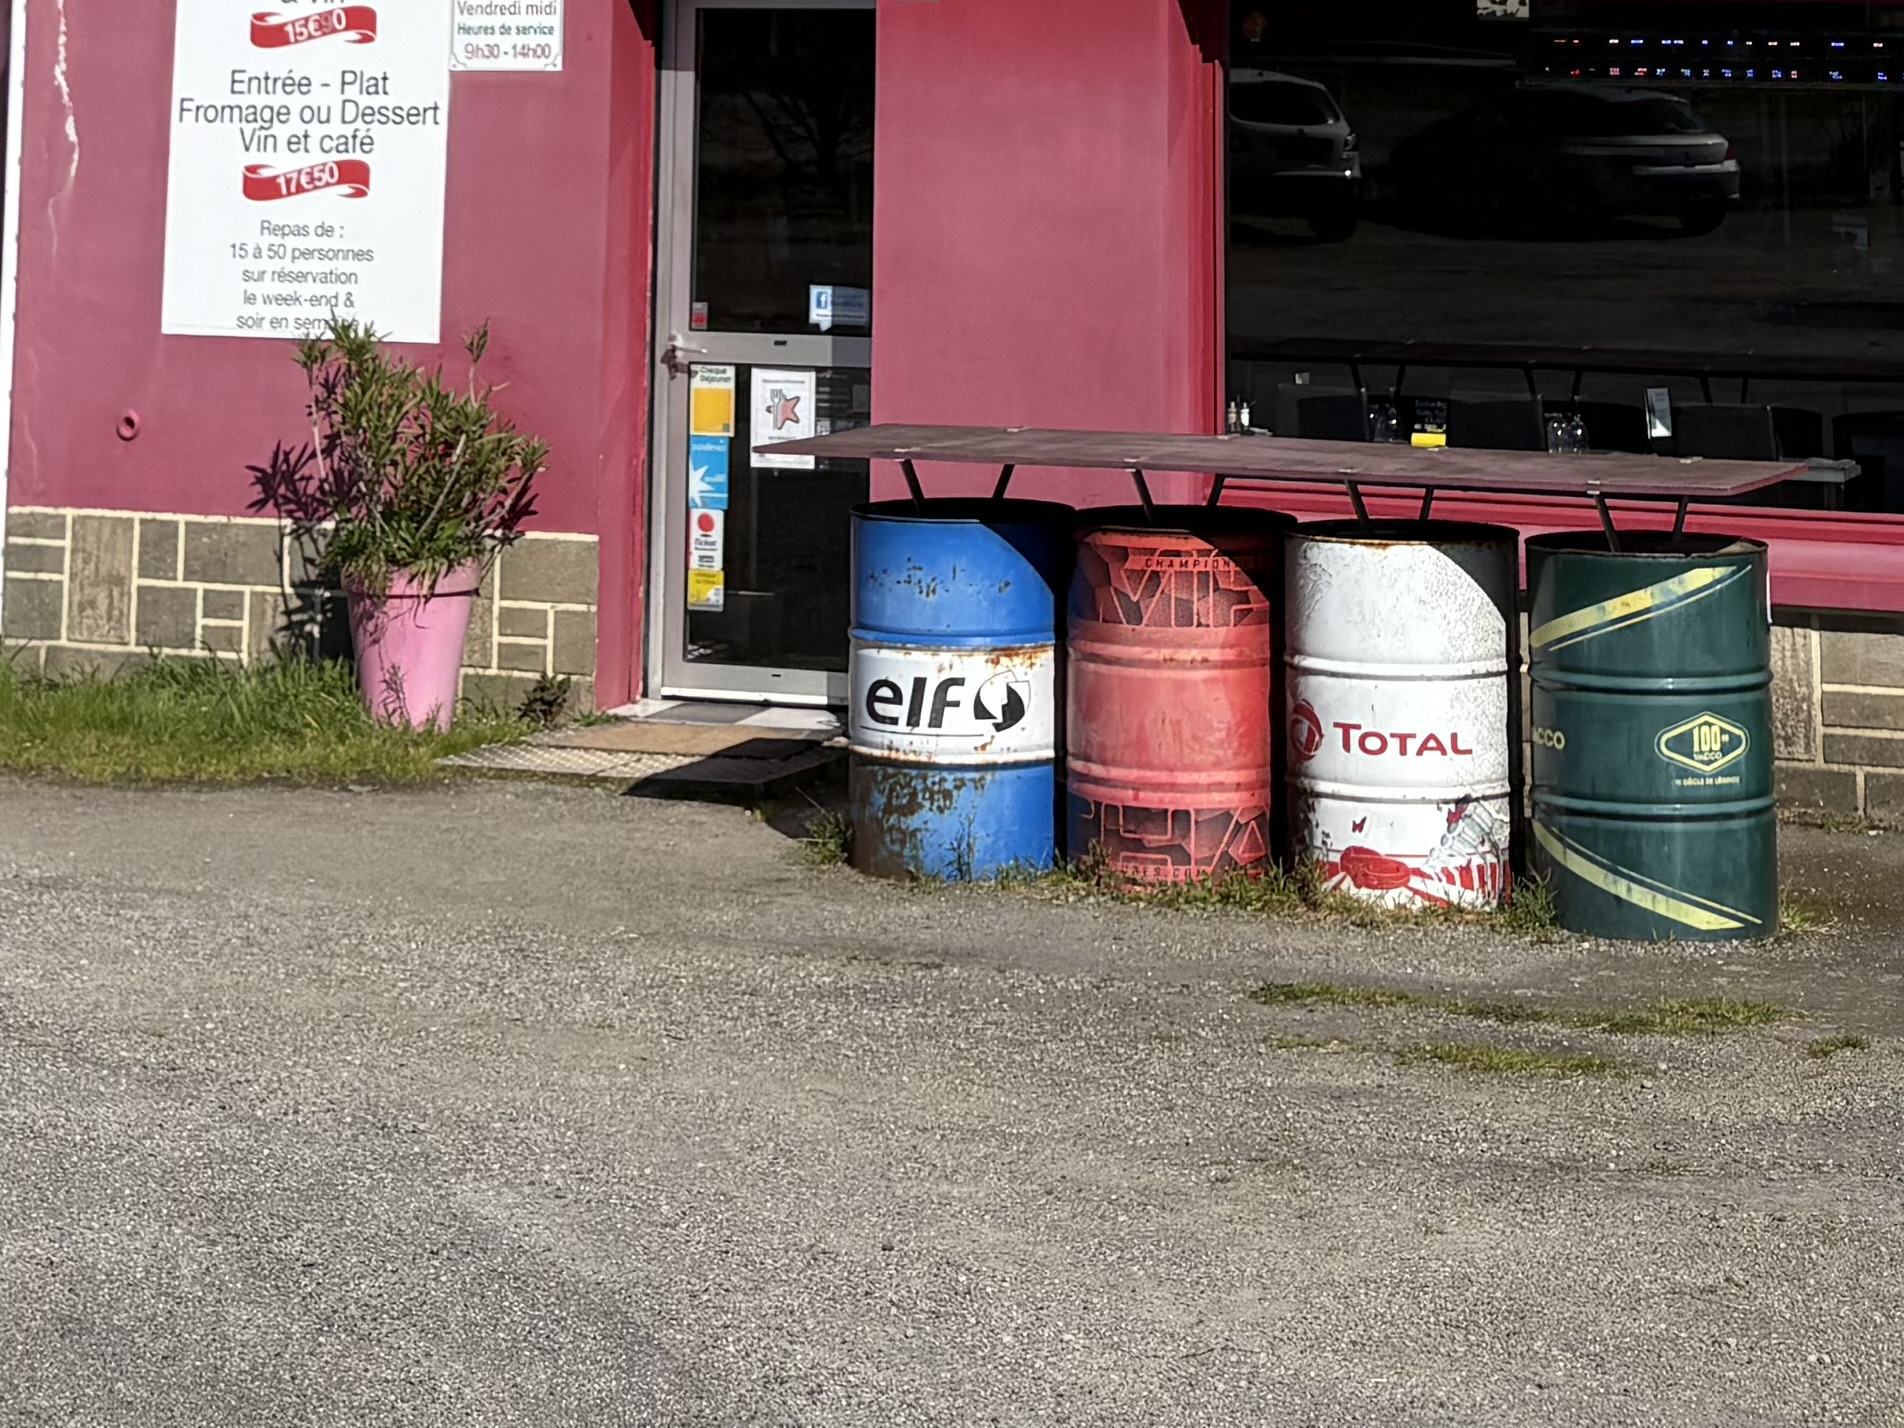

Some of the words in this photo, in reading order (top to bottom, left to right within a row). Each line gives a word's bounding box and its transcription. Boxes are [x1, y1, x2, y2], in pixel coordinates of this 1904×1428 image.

[457, 0, 521, 15] Vendredi
[526, 0, 557, 15] midi
[457, 22, 495, 35] Heures
[498, 22, 512, 35] de
[516, 22, 554, 35] service
[464, 42, 500, 60] 9h30
[512, 43, 552, 59] 14h00
[230, 69, 312, 95] Entrée
[340, 70, 390, 96] Plat
[178, 98, 291, 130] Fromage
[299, 104, 331, 124] ou
[341, 99, 440, 126] Dessert
[239, 127, 277, 153] Vin
[287, 129, 311, 153] et
[319, 127, 375, 154] café
[276, 162, 339, 195] 17€50
[260, 220, 310, 239] Repas
[314, 221, 335, 238] de
[230, 243, 248, 259] 15
[253, 242, 262, 259] à
[267, 243, 287, 259] 50
[291, 248, 374, 264] personnes
[242, 269, 267, 283] sur
[271, 266, 358, 285] réservation
[243, 289, 257, 305] le
[262, 291, 339, 307] week-end
[344, 292, 355, 308] &
[236, 312, 266, 329] soir
[270, 316, 288, 329] en
[866, 677, 966, 728] elf
[1333, 722, 1473, 756] TOTAL
[1693, 725, 1721, 752] 100
